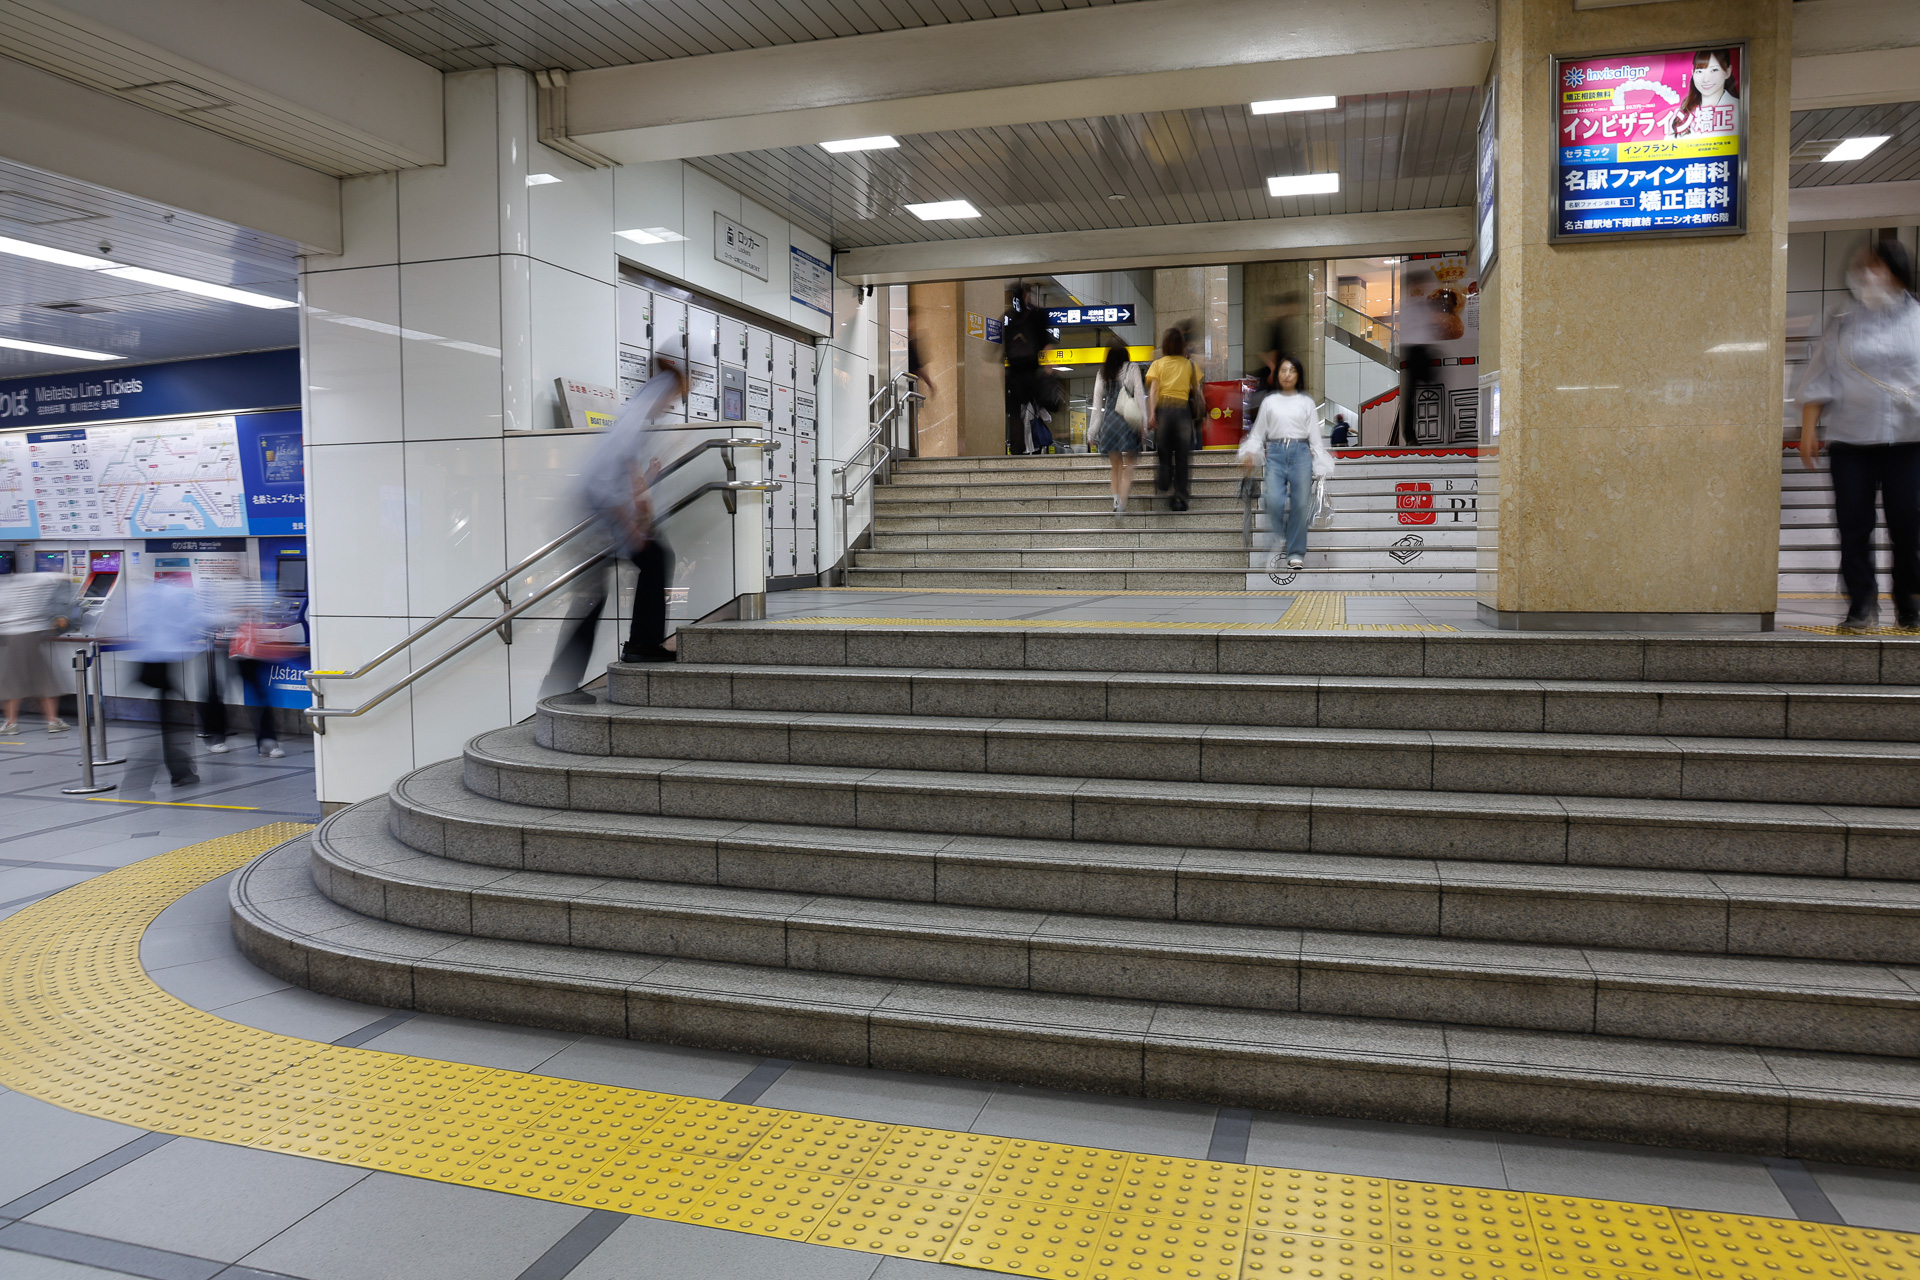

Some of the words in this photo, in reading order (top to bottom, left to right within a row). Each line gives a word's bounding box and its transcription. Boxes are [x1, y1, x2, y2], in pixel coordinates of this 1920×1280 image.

[1587, 65, 1646, 81] invisalign
[1565, 90, 1612, 102] 矯正相談無料
[1563, 105, 1733, 141] インビザライン矯正
[1565, 147, 1610, 158] セラミック
[1565, 161, 1730, 192] 名駅ファイン歯科
[1568, 200, 1616, 209] 名駅ファイン歯科
[1639, 186, 1730, 212] 矯正歯科
[1565, 216, 1652, 230] 名古屋駅地下街直結
[1654, 212, 1729, 225] エニシオ名駅6階
[738, 231, 760, 249] ロッカー
[35, 386, 78, 402] Meitetsu
[80, 382, 102, 398] Line
[103, 378, 143, 396] Tickets
[590, 416, 602, 426] BOAT
